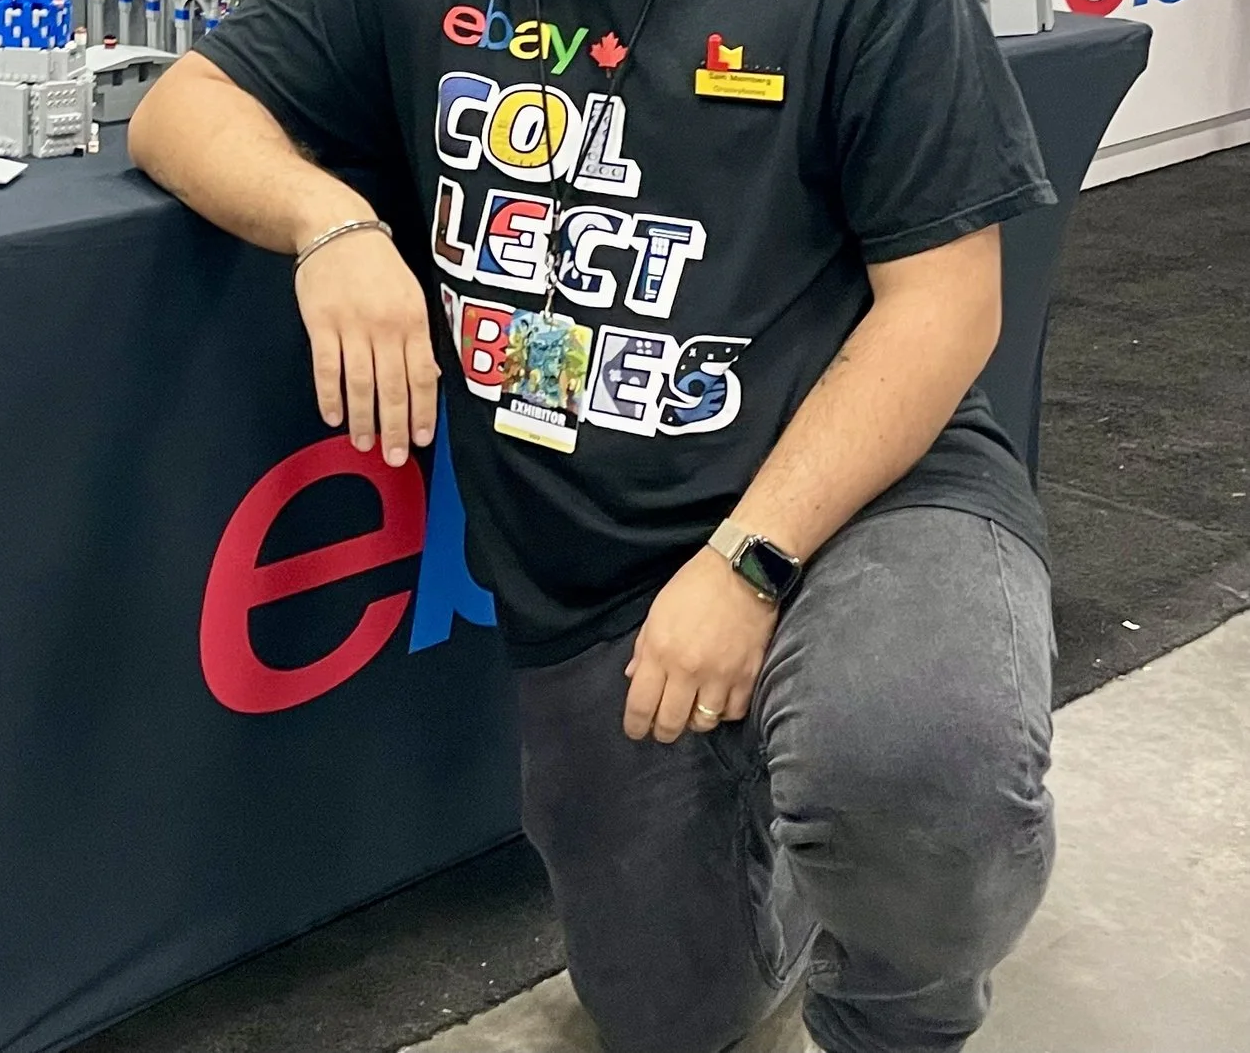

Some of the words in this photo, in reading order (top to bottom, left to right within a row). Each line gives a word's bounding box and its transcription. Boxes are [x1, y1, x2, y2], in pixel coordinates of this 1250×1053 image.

[434, 70, 642, 199] COL
[431, 174, 707, 319] LECT
[510, 399, 567, 427] EXHIBITOR
